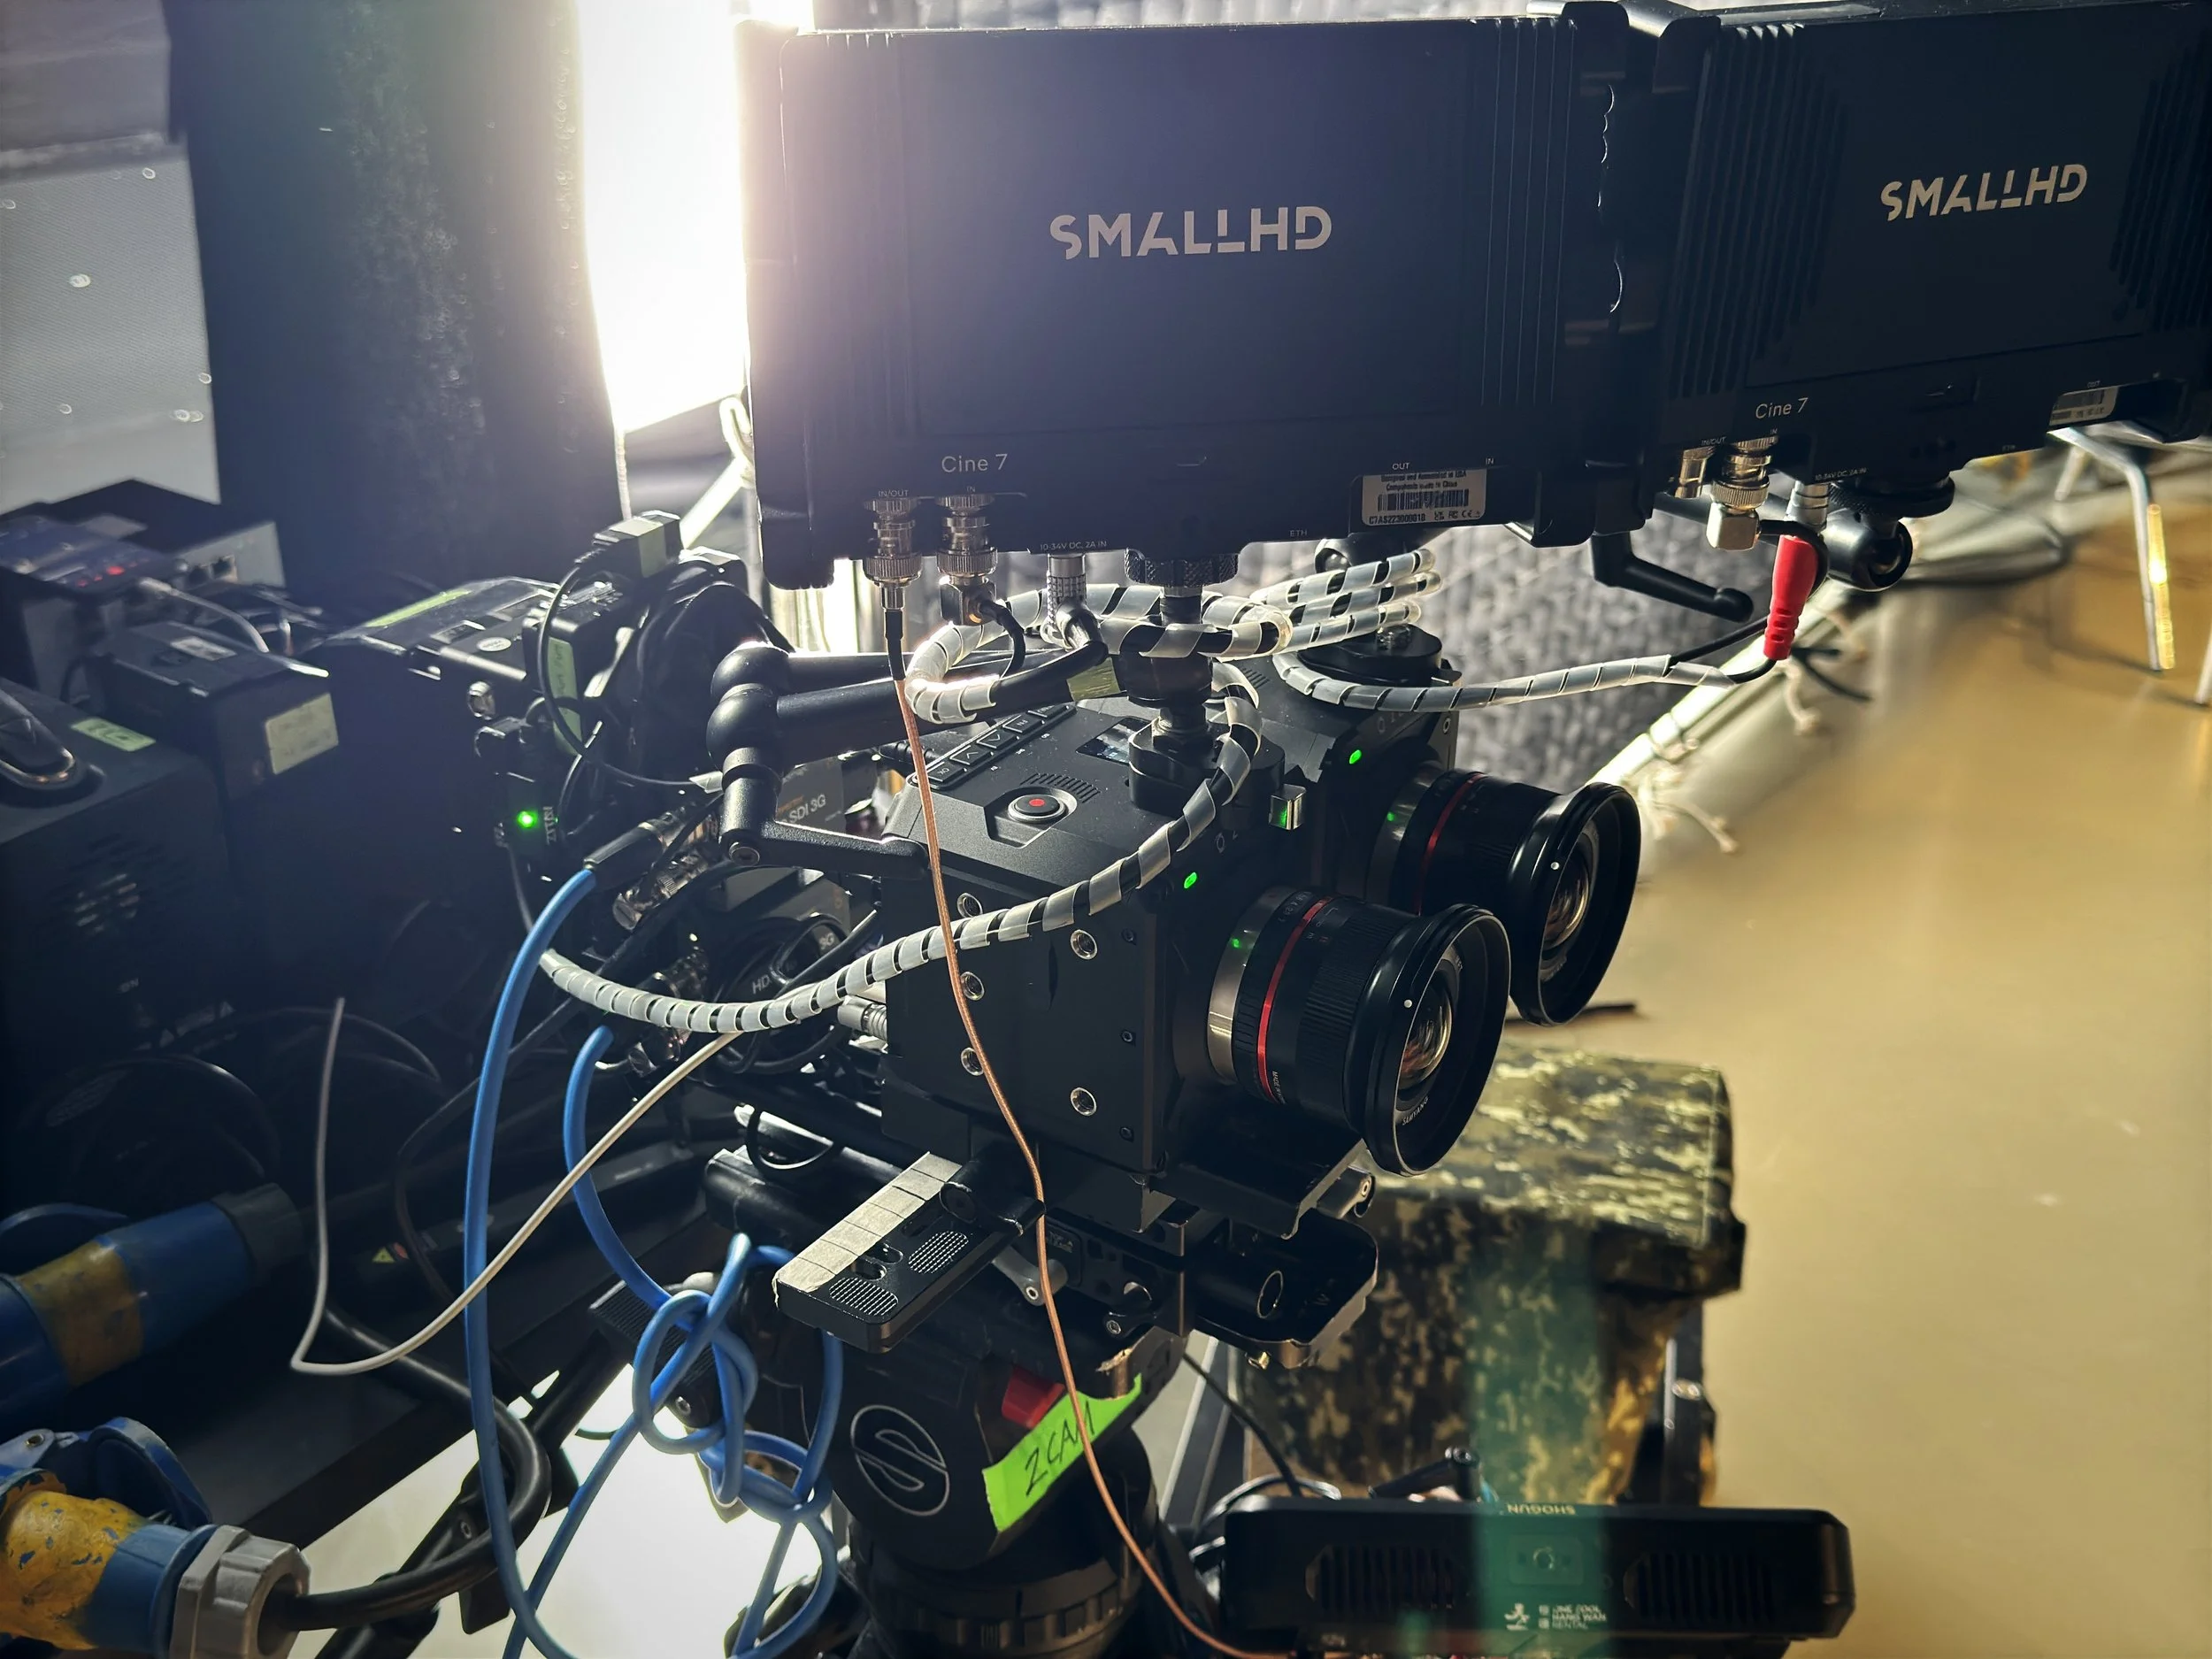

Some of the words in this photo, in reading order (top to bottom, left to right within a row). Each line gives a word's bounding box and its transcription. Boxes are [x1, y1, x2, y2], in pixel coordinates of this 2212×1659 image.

[1880, 163, 2088, 221] SMALLHD
[1049, 205, 1333, 260] SMALLHD
[1755, 402, 1792, 419] Cine
[1797, 397, 1809, 413] 7
[941, 455, 988, 472] Cine
[995, 453, 1008, 470] 7
[1392, 462, 1410, 471] OUT
[788, 802, 809, 824] SDI
[1402, 1095, 1429, 1126] SAMYANG
[1507, 1503, 1577, 1516] SHOGUN
